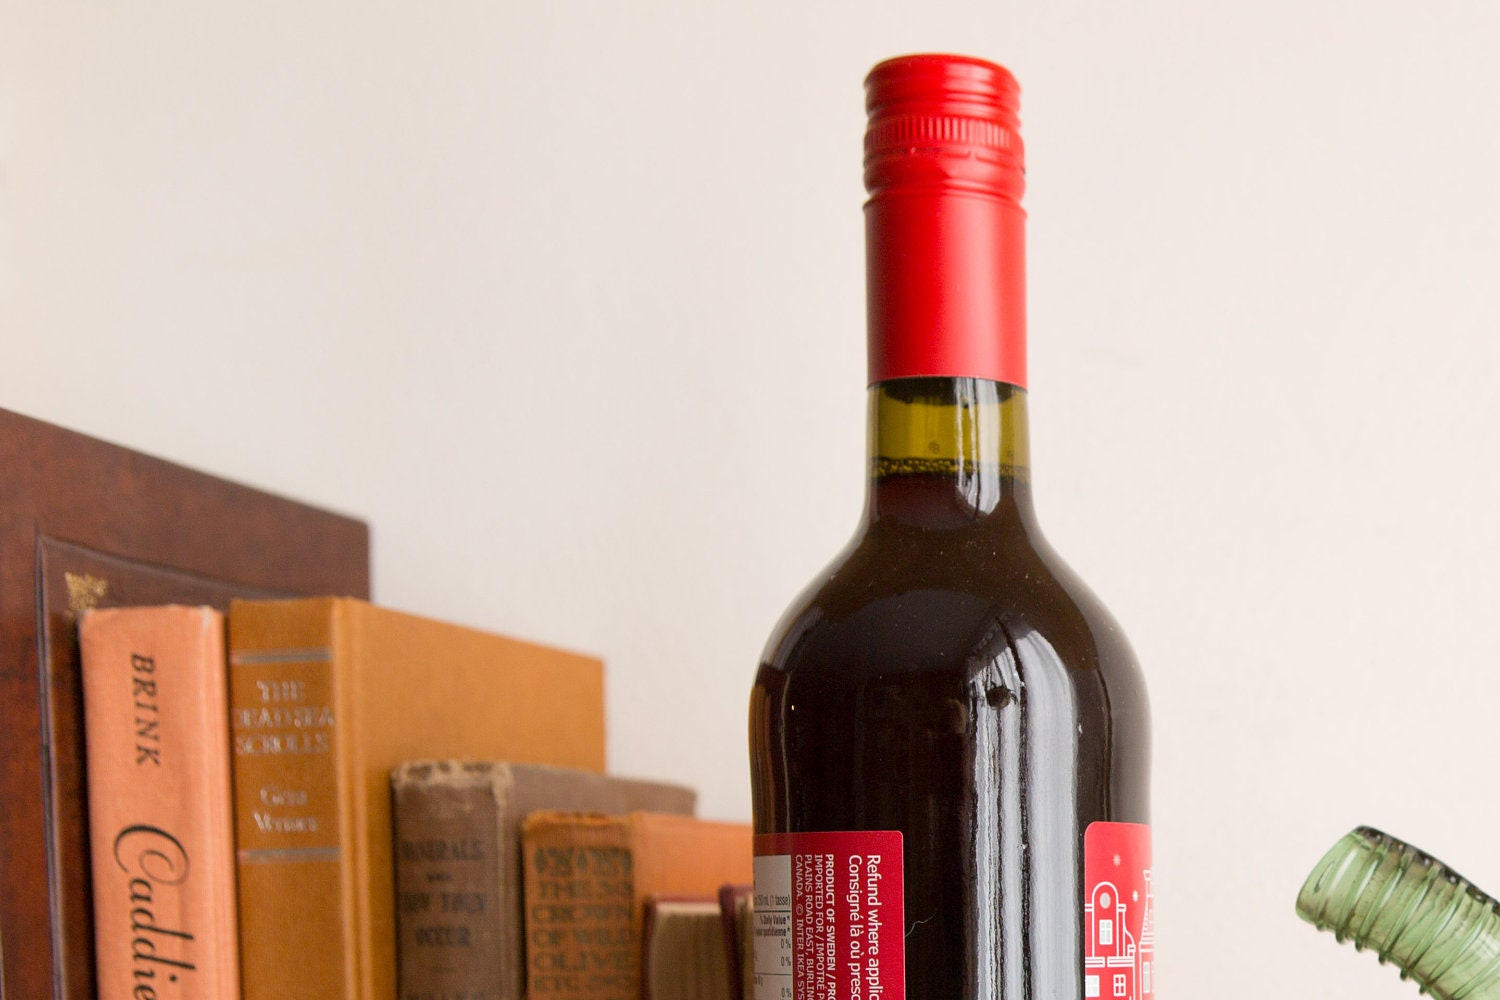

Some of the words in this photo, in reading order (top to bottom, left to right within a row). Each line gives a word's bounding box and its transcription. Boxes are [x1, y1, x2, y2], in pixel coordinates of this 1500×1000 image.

[130, 651, 161, 767] BRINK
[256, 680, 306, 702] THE
[795, 854, 804, 900] CANADA.
[804, 854, 813, 893] PLAINS
[814, 854, 824, 910] IMPORTED
[825, 854, 835, 906] PRODUCT
[846, 854, 864, 921] Consigné
[867, 854, 882, 906] Refund
[805, 894, 814, 925] ROAD
[815, 911, 824, 933] FOR
[826, 908, 835, 923] OF
[796, 918, 804, 950] INTER
[805, 926, 814, 956] EAST,
[826, 925, 836, 971] SWEDEN
[849, 924, 864, 938] là
[849, 940, 864, 959] où
[867, 909, 883, 955] where
[796, 953, 805, 978] IKEA
[815, 943, 827, 990] IMPOTRÉ
